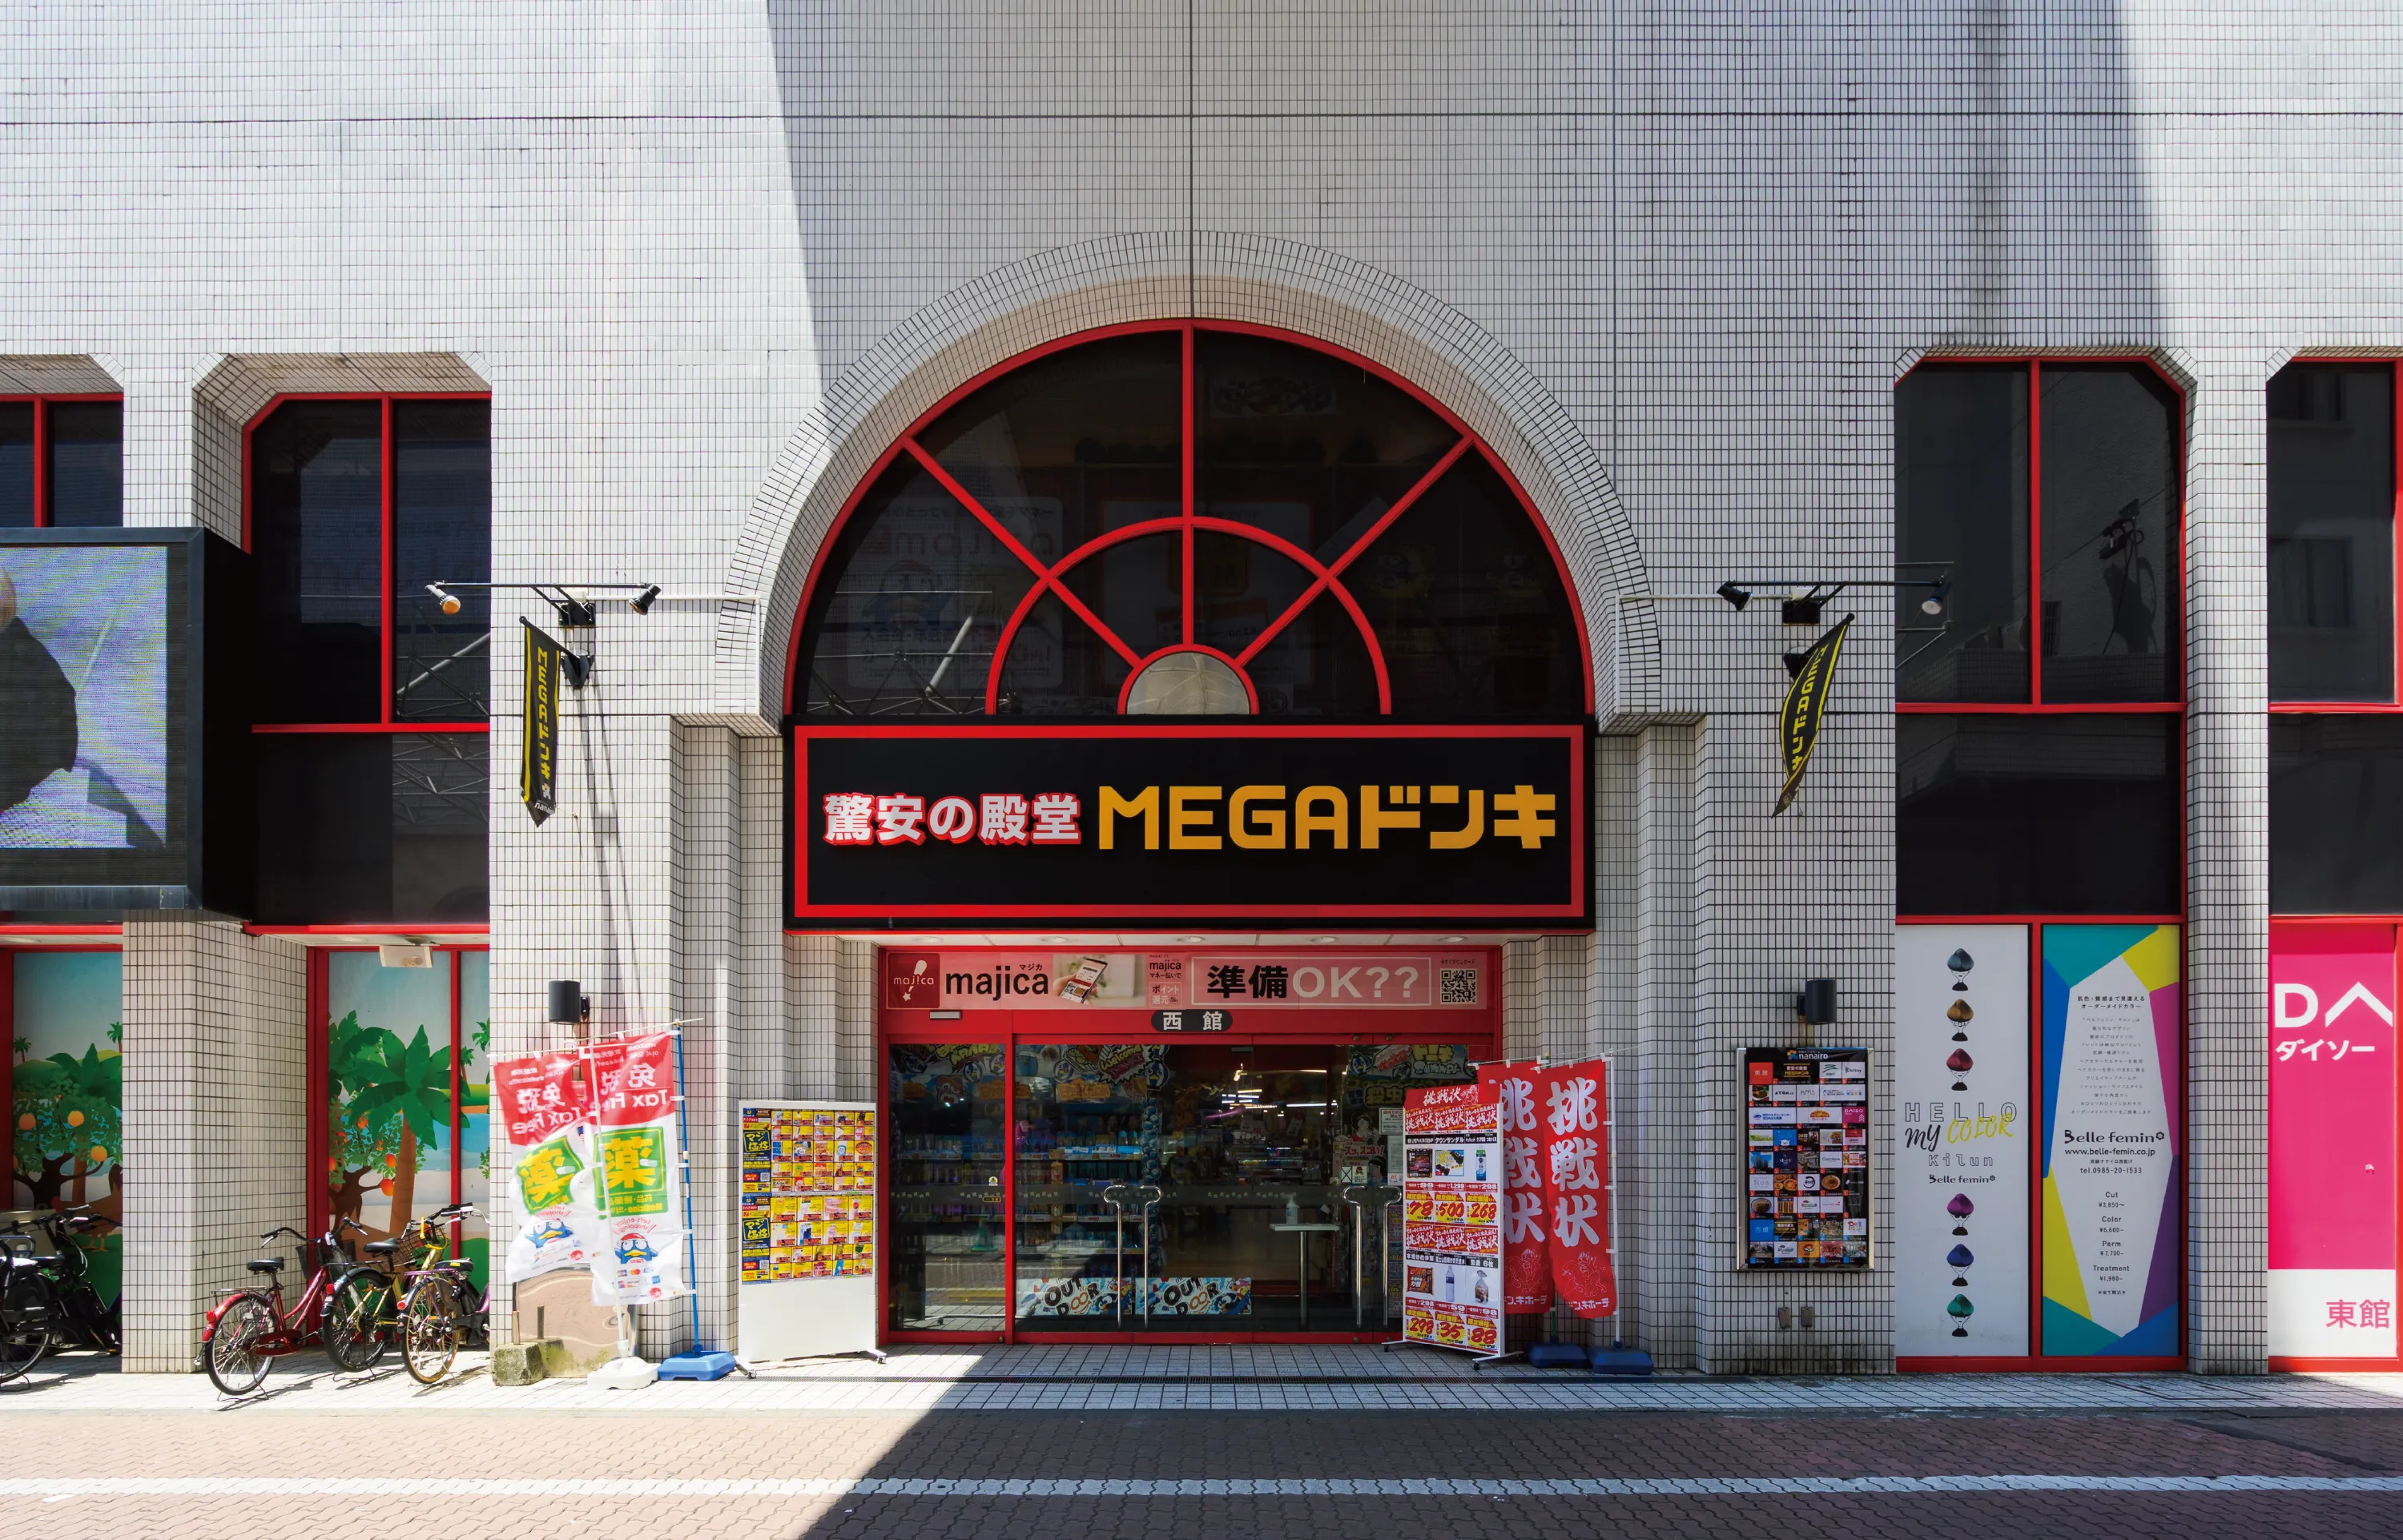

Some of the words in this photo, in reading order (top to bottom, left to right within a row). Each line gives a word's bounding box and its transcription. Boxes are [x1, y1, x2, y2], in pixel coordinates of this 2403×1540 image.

[537, 646, 550, 781] MEGAドンキ
[823, 792, 1081, 846] 驚安の殿堂
[1099, 785, 1556, 850] MEGAドンキ
[1149, 959, 1181, 971] majica
[945, 966, 1049, 1001] majica
[1152, 985, 1179, 994] ポイント
[1207, 965, 1418, 999] 準備OK??
[1100, 1044, 1141, 1071] Welcome
[1798, 1051, 1828, 1060] nanairo
[2275, 1038, 2375, 1062] ダイソー
[1423, 1088, 1461, 1106] 挑戦状
[1905, 1102, 2017, 1122] HELLO
[1946, 1112, 2014, 1144] COLOR
[2064, 1129, 2105, 1144] Belle
[2108, 1131, 2155, 1144] femin
[1546, 1076, 1600, 1247] 挑戦状
[2064, 1148, 2155, 1157] www.belle-femin.co.jp
[1929, 1174, 1956, 1184] Belle
[1410, 1200, 1434, 1216] 78
[1439, 1202, 1465, 1217] 500
[1470, 1203, 1497, 1220] 268
[2325, 1299, 2391, 1329] 東館
[1410, 1317, 1434, 1335] 298
[1439, 1322, 1465, 1339] 35
[1471, 1328, 1497, 1345] 88
